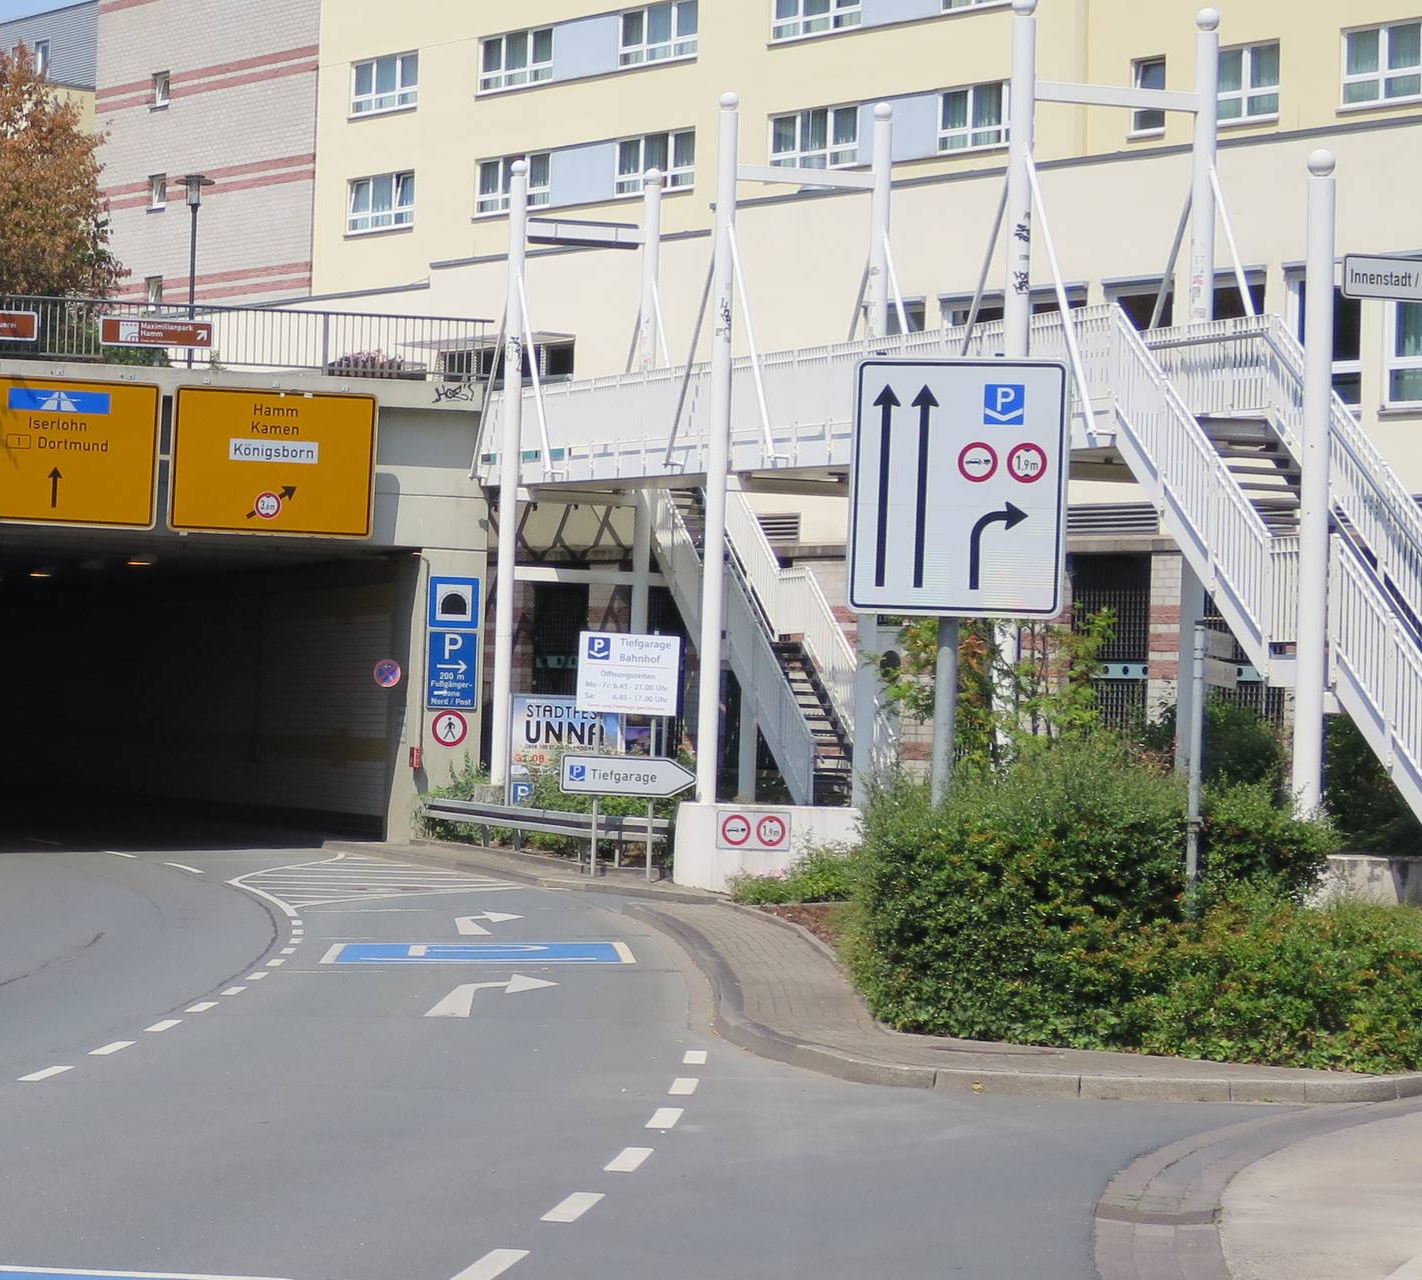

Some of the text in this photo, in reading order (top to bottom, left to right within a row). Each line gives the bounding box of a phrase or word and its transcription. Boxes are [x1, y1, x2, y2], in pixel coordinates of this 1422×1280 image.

[1350, 267, 1412, 288] Innenstadt
[996, 387, 1015, 412] P
[253, 403, 299, 417] Hamm
[28, 416, 87, 432] Iserlohn
[251, 421, 299, 436] Kamen
[38, 436, 109, 452] Dortmund
[233, 442, 314, 460] Königsborn
[444, 633, 463, 659] P
[594, 638, 605, 652] P
[620, 638, 672, 651] Tiefgarage
[619, 653, 661, 663] Bahnhof
[439, 672, 454, 680] 200
[655, 684, 669, 692] Uhr
[455, 698, 471, 706] Post
[526, 704, 603, 720] STADTFES
[525, 720, 604, 746] UNNA
[590, 768, 658, 785] Tiefgarage
